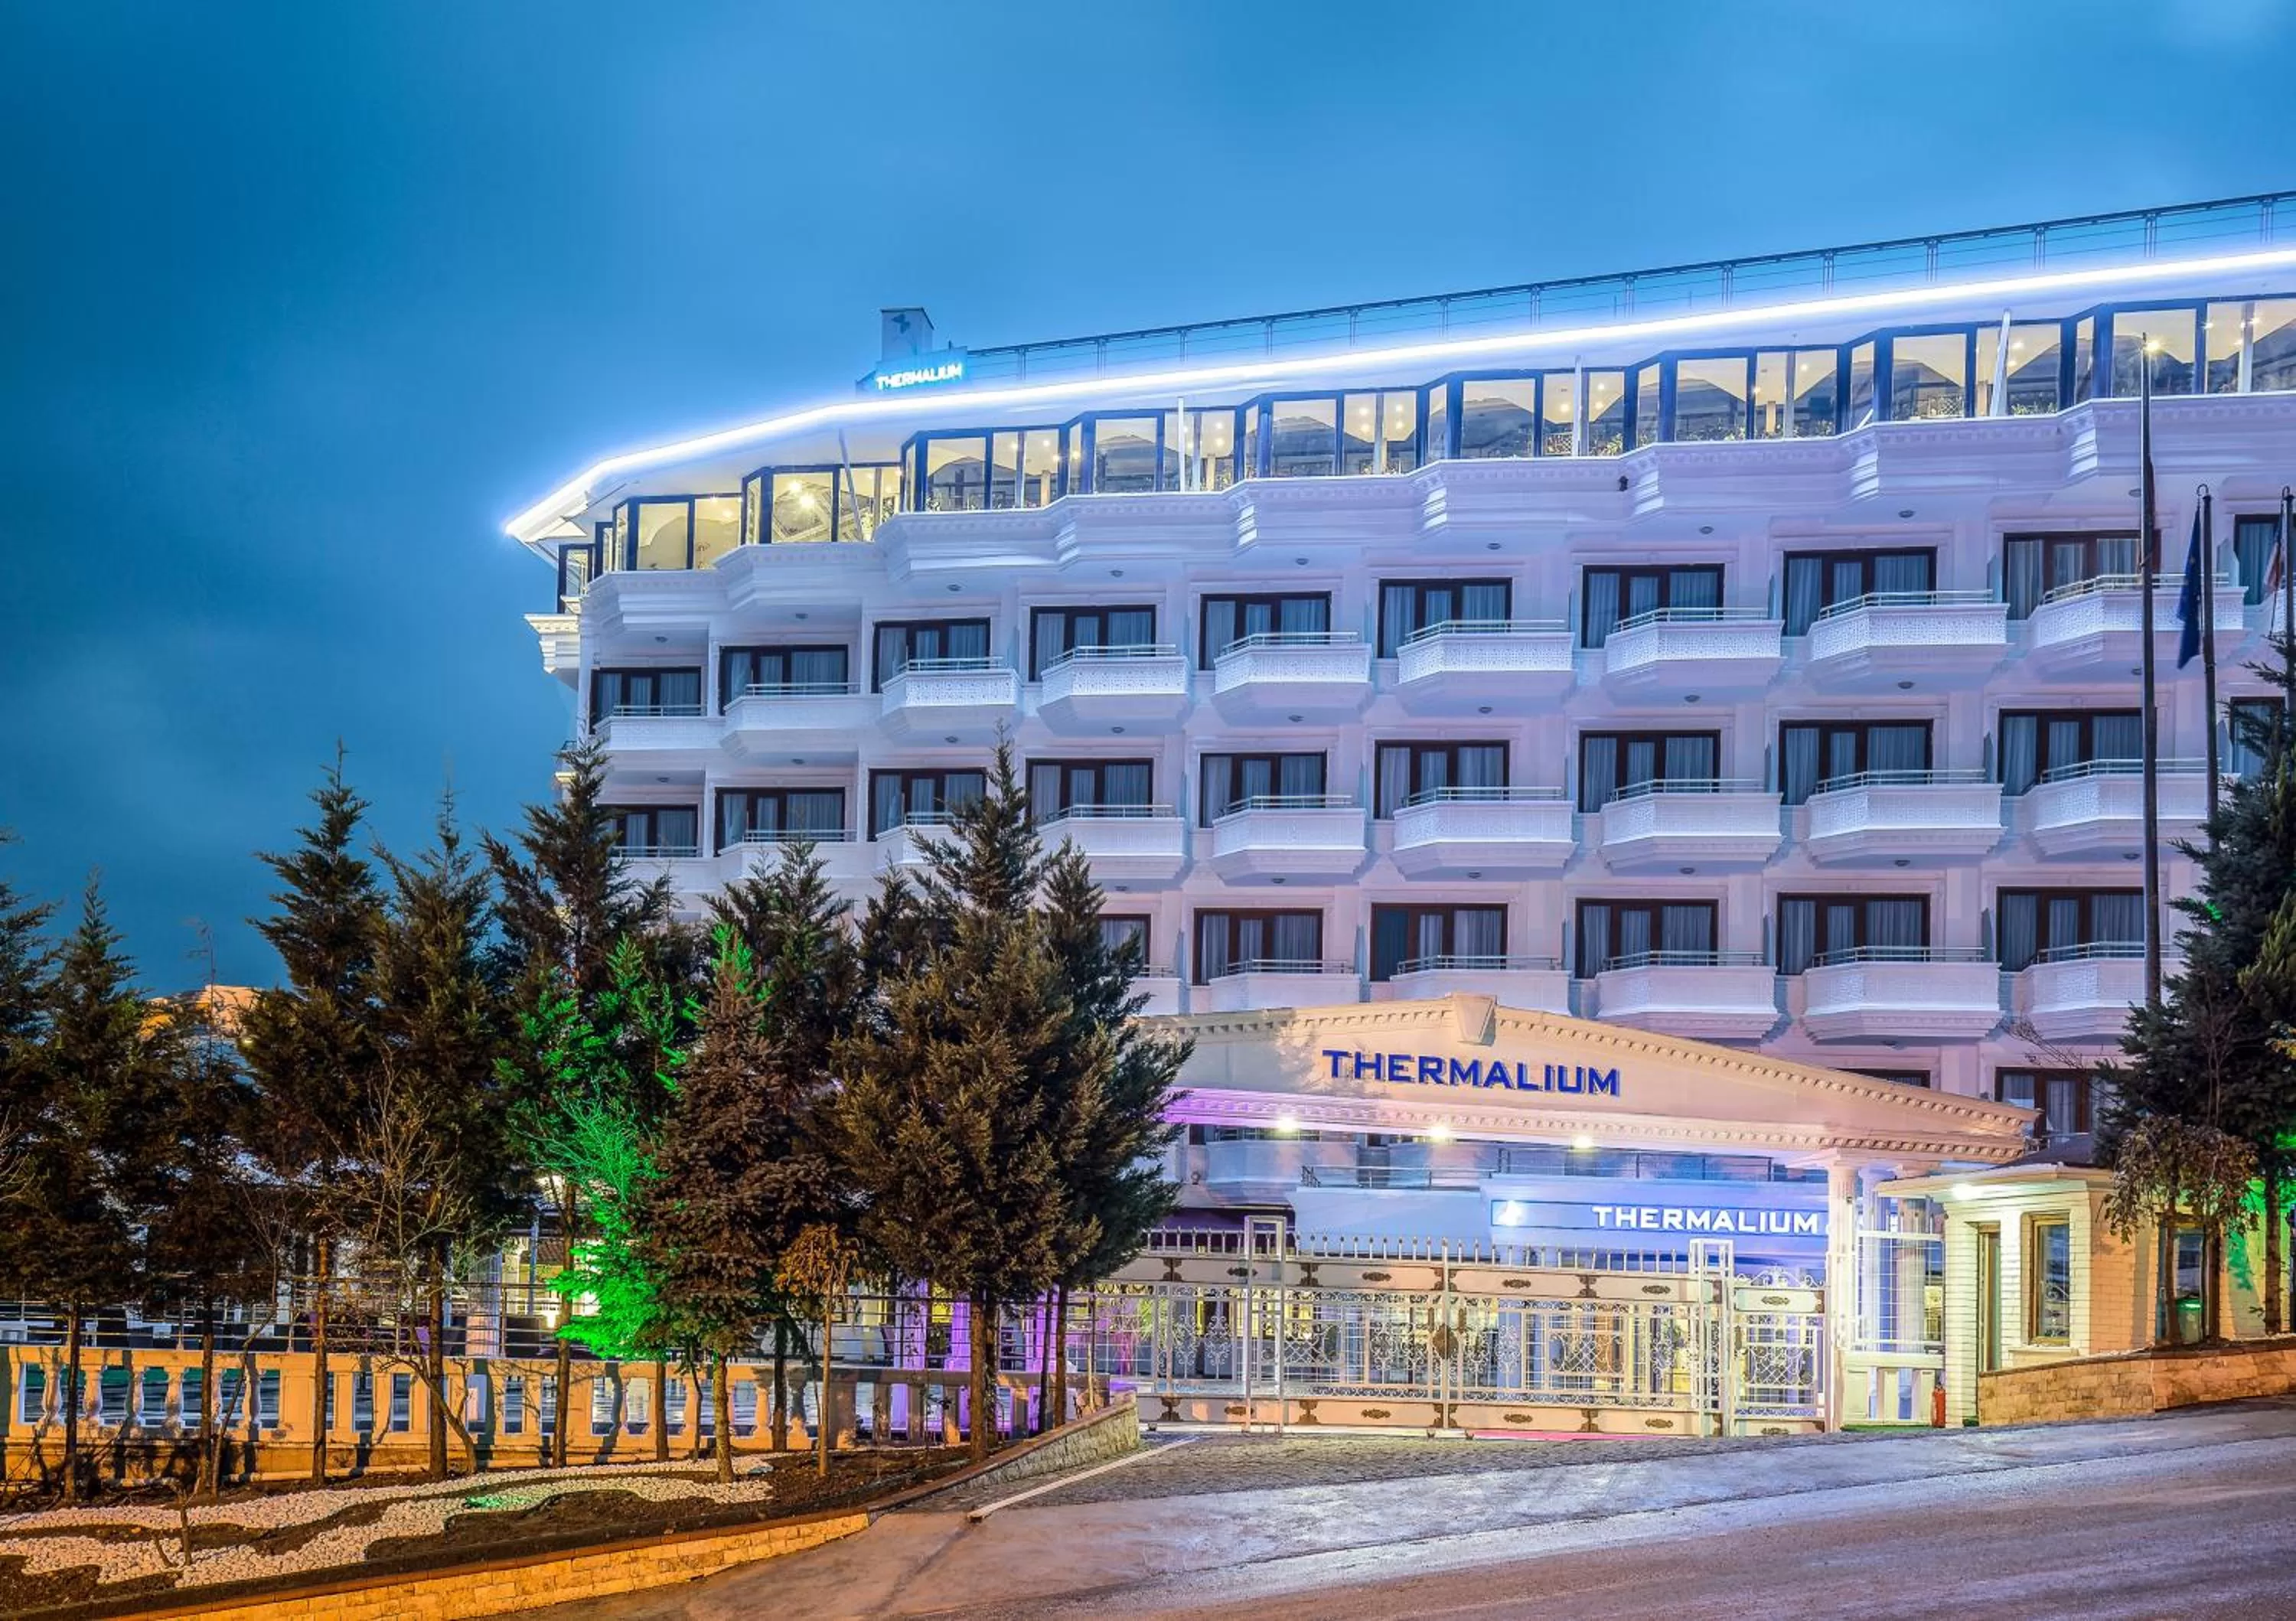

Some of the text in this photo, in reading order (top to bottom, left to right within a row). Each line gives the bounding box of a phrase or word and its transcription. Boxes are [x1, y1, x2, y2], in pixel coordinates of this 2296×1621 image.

[876, 362, 962, 390] THERMALIUM
[1322, 1049, 1620, 1096] THERMALIUM
[1592, 1205, 1818, 1235] THERMALIUM
